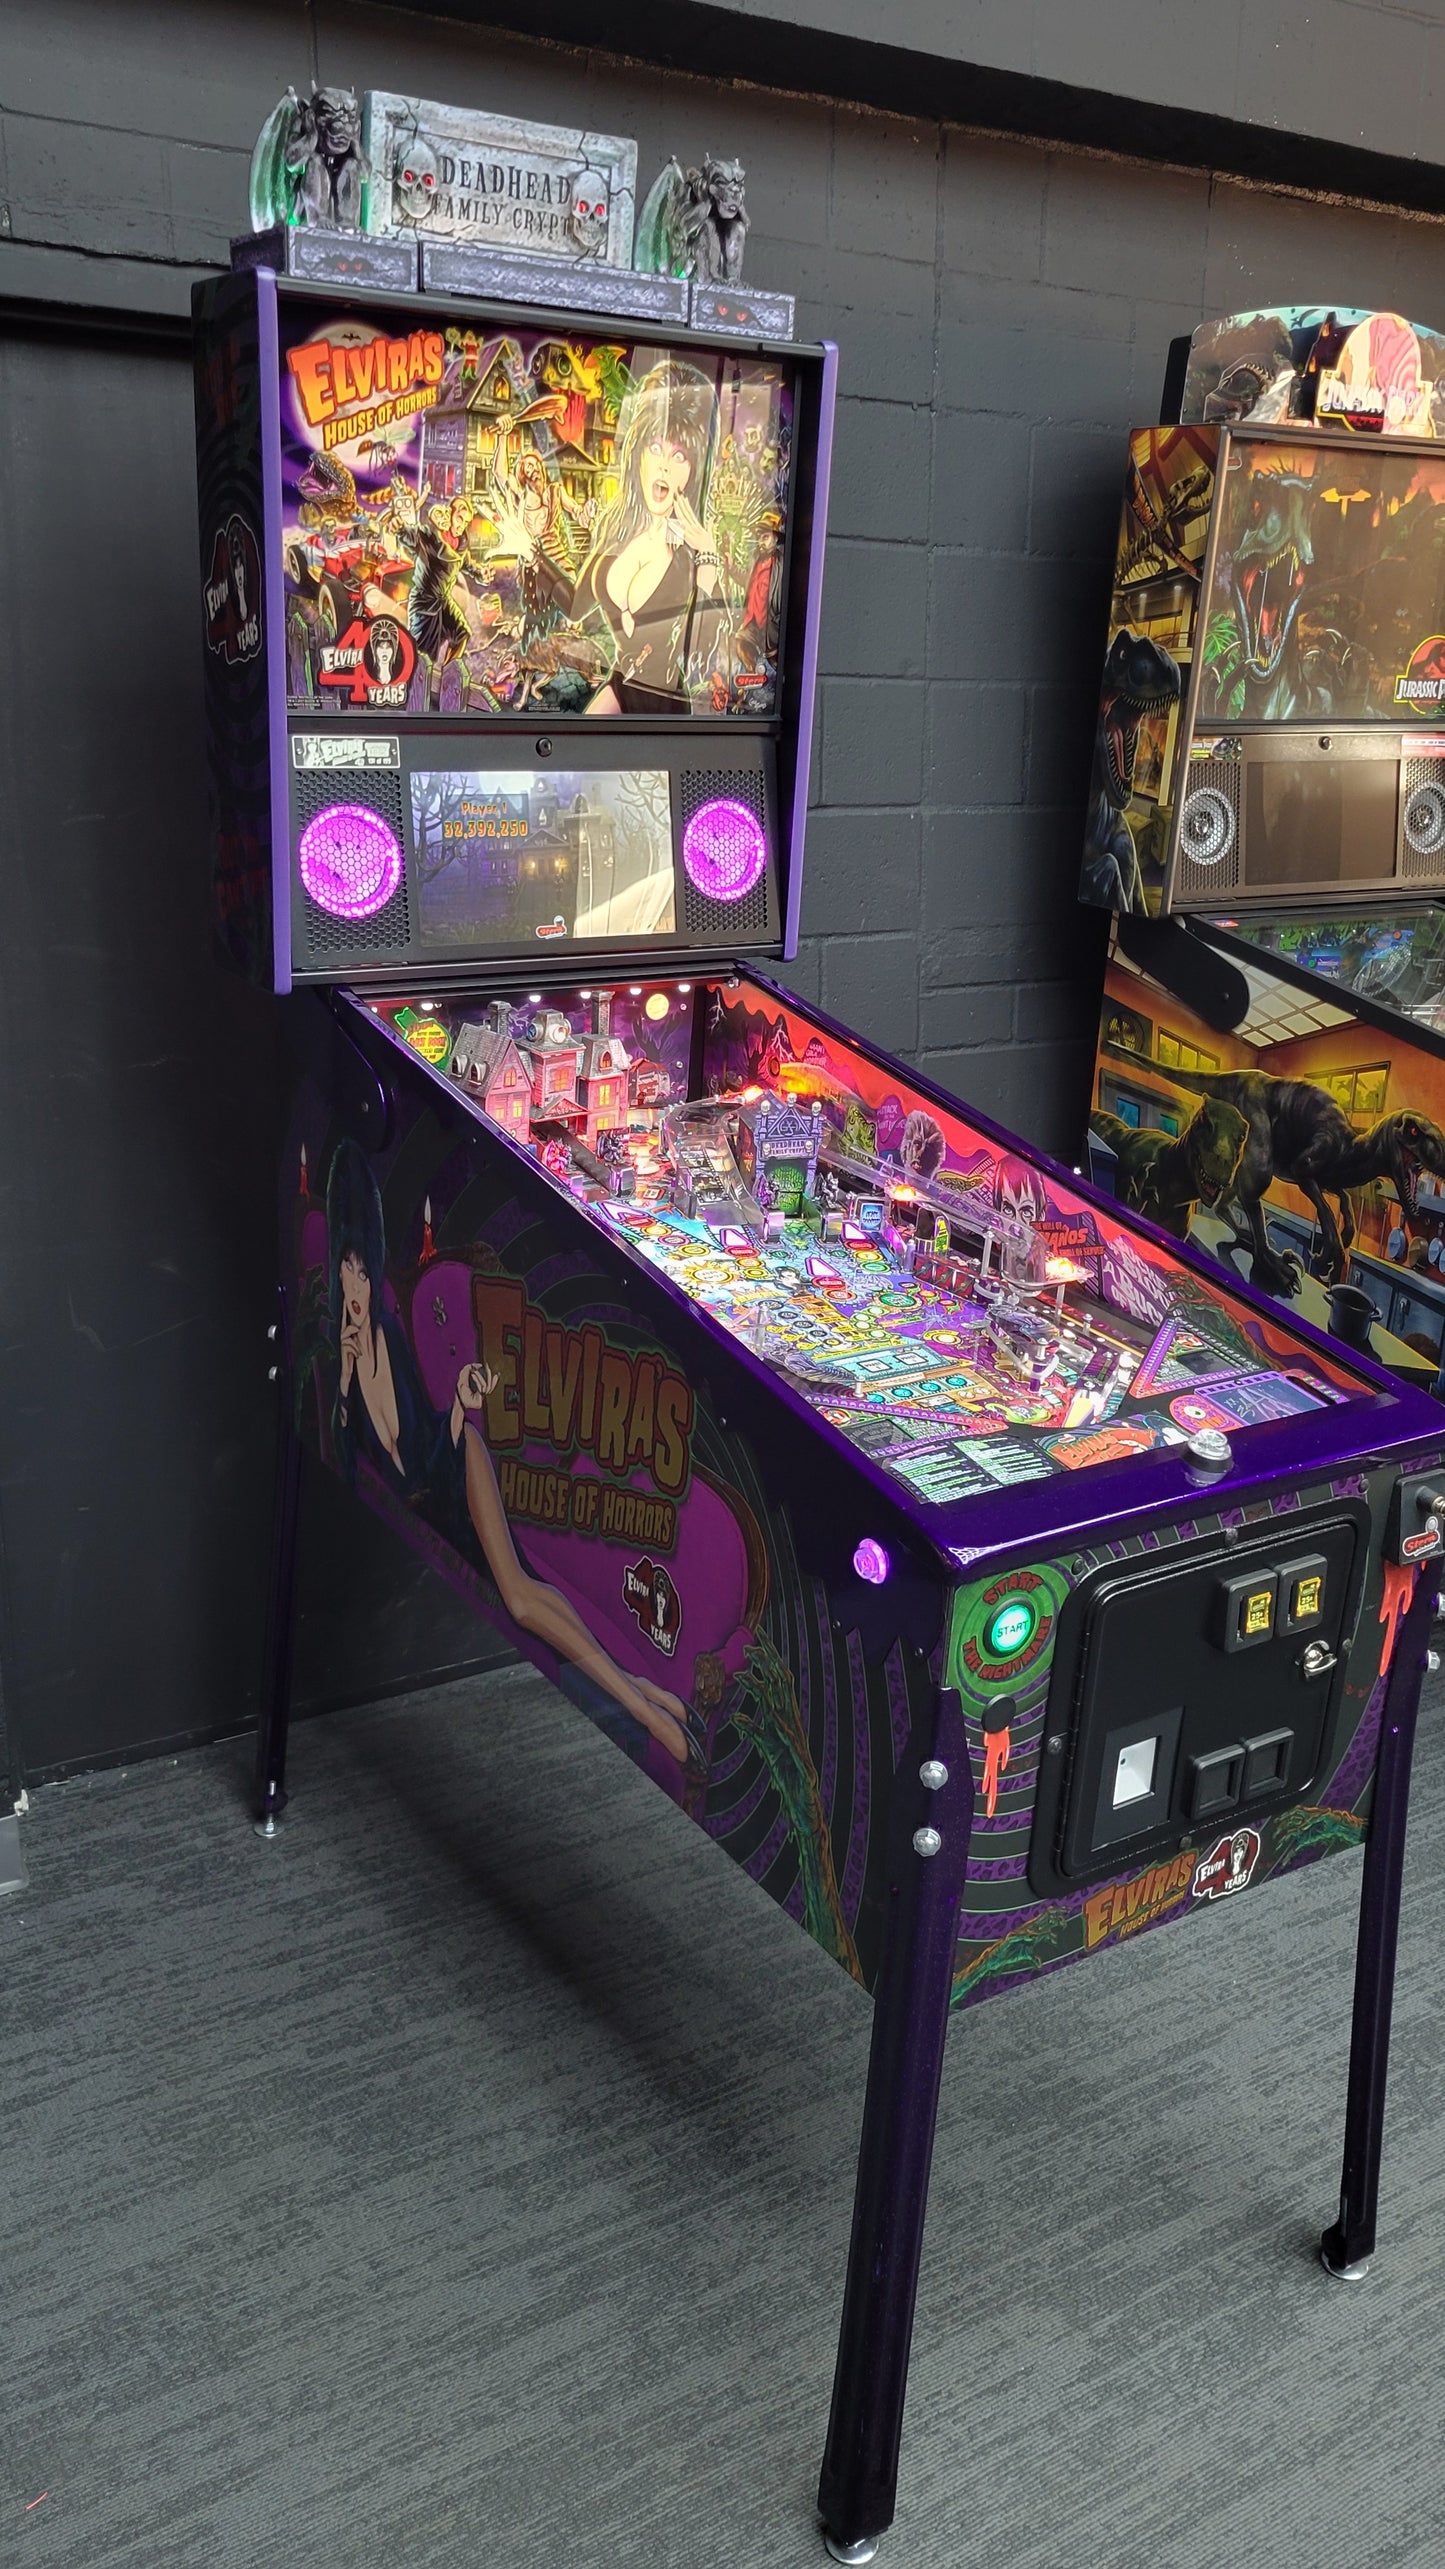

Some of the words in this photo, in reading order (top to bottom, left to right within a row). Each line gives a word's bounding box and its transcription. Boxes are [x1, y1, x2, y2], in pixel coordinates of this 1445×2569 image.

[440, 155, 571, 204] DEADHEAD
[432, 192, 504, 226] FAMILY
[512, 208, 571, 236] CRYPT
[323, 408, 375, 450] HOUSE
[377, 400, 394, 426] OF
[395, 386, 437, 420] HORRORS
[236, 613, 259, 652] YEARS
[319, 619, 415, 702] 40
[321, 648, 364, 673] ELVIRA
[369, 683, 407, 705] YEARS
[1396, 679, 1438, 699] JURASSIC
[461, 802, 497, 816] Player
[501, 801, 507, 814] 1
[444, 820, 529, 839] 32,392,250
[475, 1279, 691, 1490] ELVIRA'S
[501, 1461, 570, 1519] HOUSE
[574, 1483, 598, 1525] OF
[602, 1489, 672, 1543] HORRORS
[1406, 1533, 1437, 1552] Stern
[627, 1571, 649, 1598] ELVIRA
[983, 1571, 1044, 1605] START
[650, 1623, 672, 1649] YEARS
[996, 1620, 1029, 1639] START
[963, 1635, 983, 1673] THE
[977, 1615, 1053, 1680] NIGHTMARE
[1200, 1858, 1226, 1882] ELVIRA
[1224, 1869, 1248, 1890] YEARS
[1085, 1852, 1198, 1949] ELVIRA'S
[1119, 1914, 1149, 1938] HOUSE
[1150, 1905, 1161, 1918] OF
